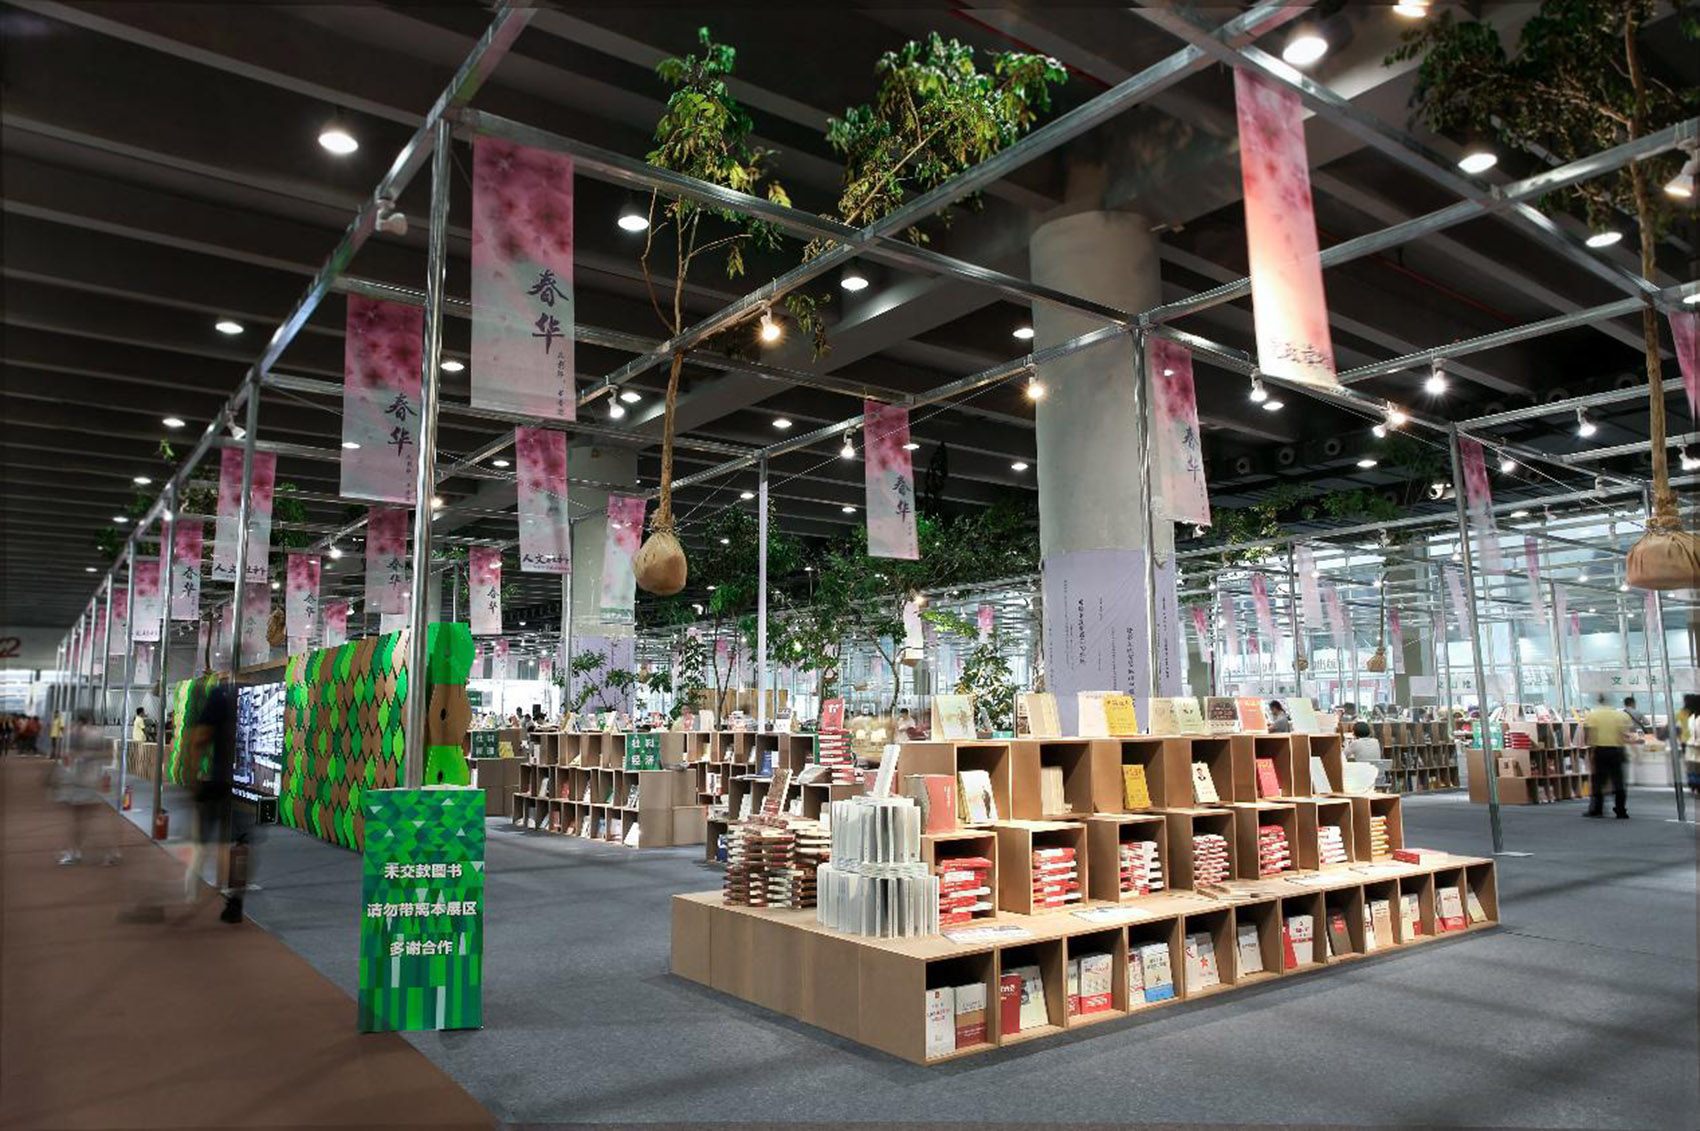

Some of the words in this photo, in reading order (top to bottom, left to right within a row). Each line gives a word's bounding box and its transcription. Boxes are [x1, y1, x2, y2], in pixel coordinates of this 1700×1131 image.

[526, 269, 569, 355] 春华
[385, 392, 417, 456] 春华
[1182, 426, 1201, 483] 春华
[892, 474, 911, 523] 春华
[384, 862, 462, 879] 未交款图书
[367, 901, 477, 918] 请勿带离本展区
[390, 940, 453, 957] 多谢合作
